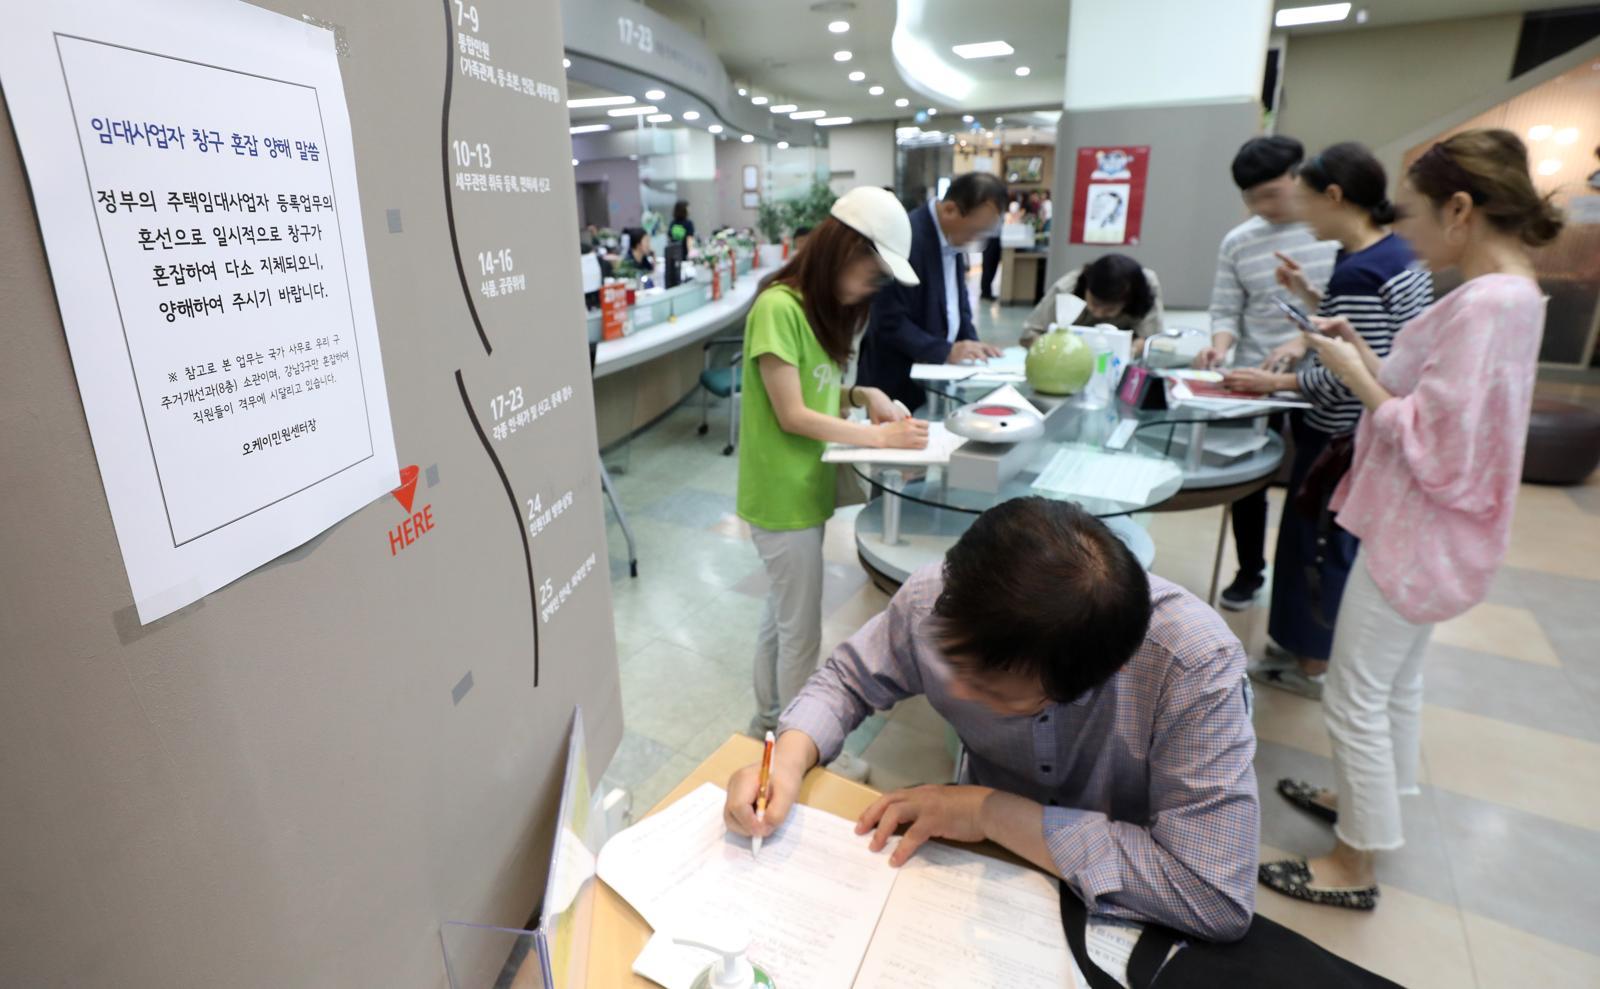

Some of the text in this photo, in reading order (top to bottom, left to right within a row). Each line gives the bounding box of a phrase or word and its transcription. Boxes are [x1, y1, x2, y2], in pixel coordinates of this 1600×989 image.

[455, 0, 479, 32] 7-9
[618, 16, 654, 53] 17-23
[91, 118, 320, 162] 임대사업자 창구 혼잡 양해 말씀
[453, 140, 491, 168] 10-13
[455, 172, 487, 191] 세무관련
[97, 189, 334, 214] 정부의 주택임대사업자 등록업무의
[138, 223, 323, 251] 혼선으로 일시적으로 창구가
[152, 253, 324, 287] 혼잡하여 다소 지체되오니,
[478, 249, 513, 276] 14-16
[159, 281, 328, 323] 양해하여 주시기 바랍니다.
[184, 362, 217, 381] 참고로
[222, 358, 232, 372] 본
[235, 351, 264, 369] 업무는
[268, 345, 285, 361] 국가
[288, 340, 312, 355] 사무로
[315, 335, 330, 349] 우리
[333, 334, 340, 345] 구
[160, 350, 350, 410] 주거개선과(8층) 소관이며, 강남3구만 혼잡하여
[193, 372, 337, 425] 직원들이 격무에 시달리고 있습니다.
[490, 386, 524, 420] 17-23
[242, 418, 317, 456] 오케이민원센터장
[493, 421, 507, 440] 각종
[527, 492, 542, 521] 24
[388, 504, 434, 556] HERE
[539, 577, 553, 605] 25
